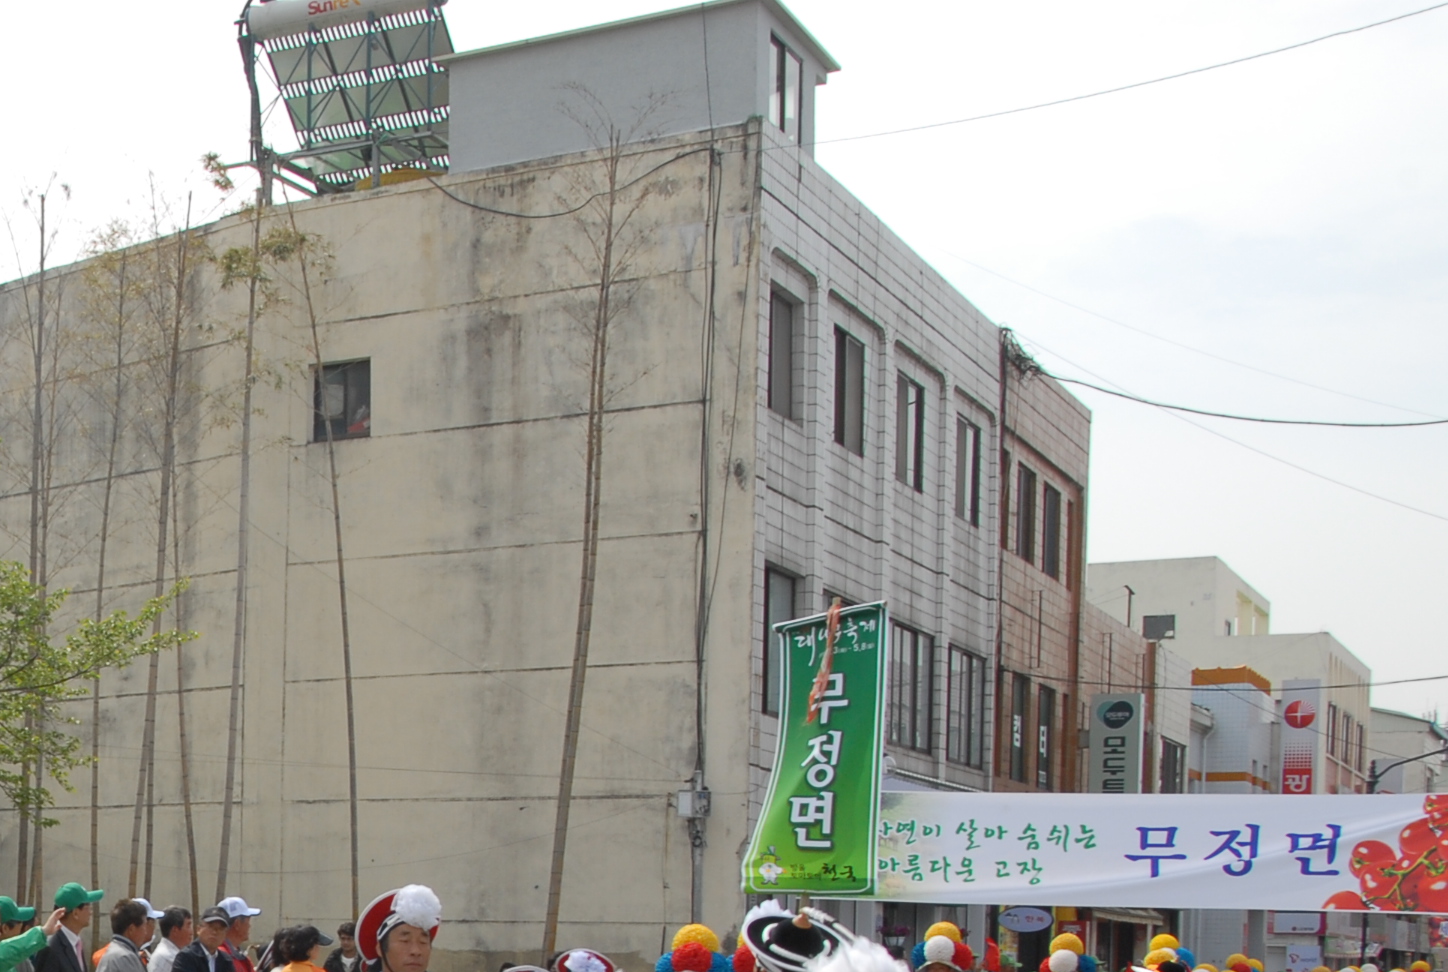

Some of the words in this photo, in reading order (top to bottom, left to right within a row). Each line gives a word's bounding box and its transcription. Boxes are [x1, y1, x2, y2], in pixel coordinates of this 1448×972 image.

[789, 672, 850, 848] 무정면
[955, 818, 1008, 851] 살아
[1123, 823, 1342, 878] 무정면
[878, 854, 976, 883] 아름다운
[994, 857, 1044, 885] 고장
